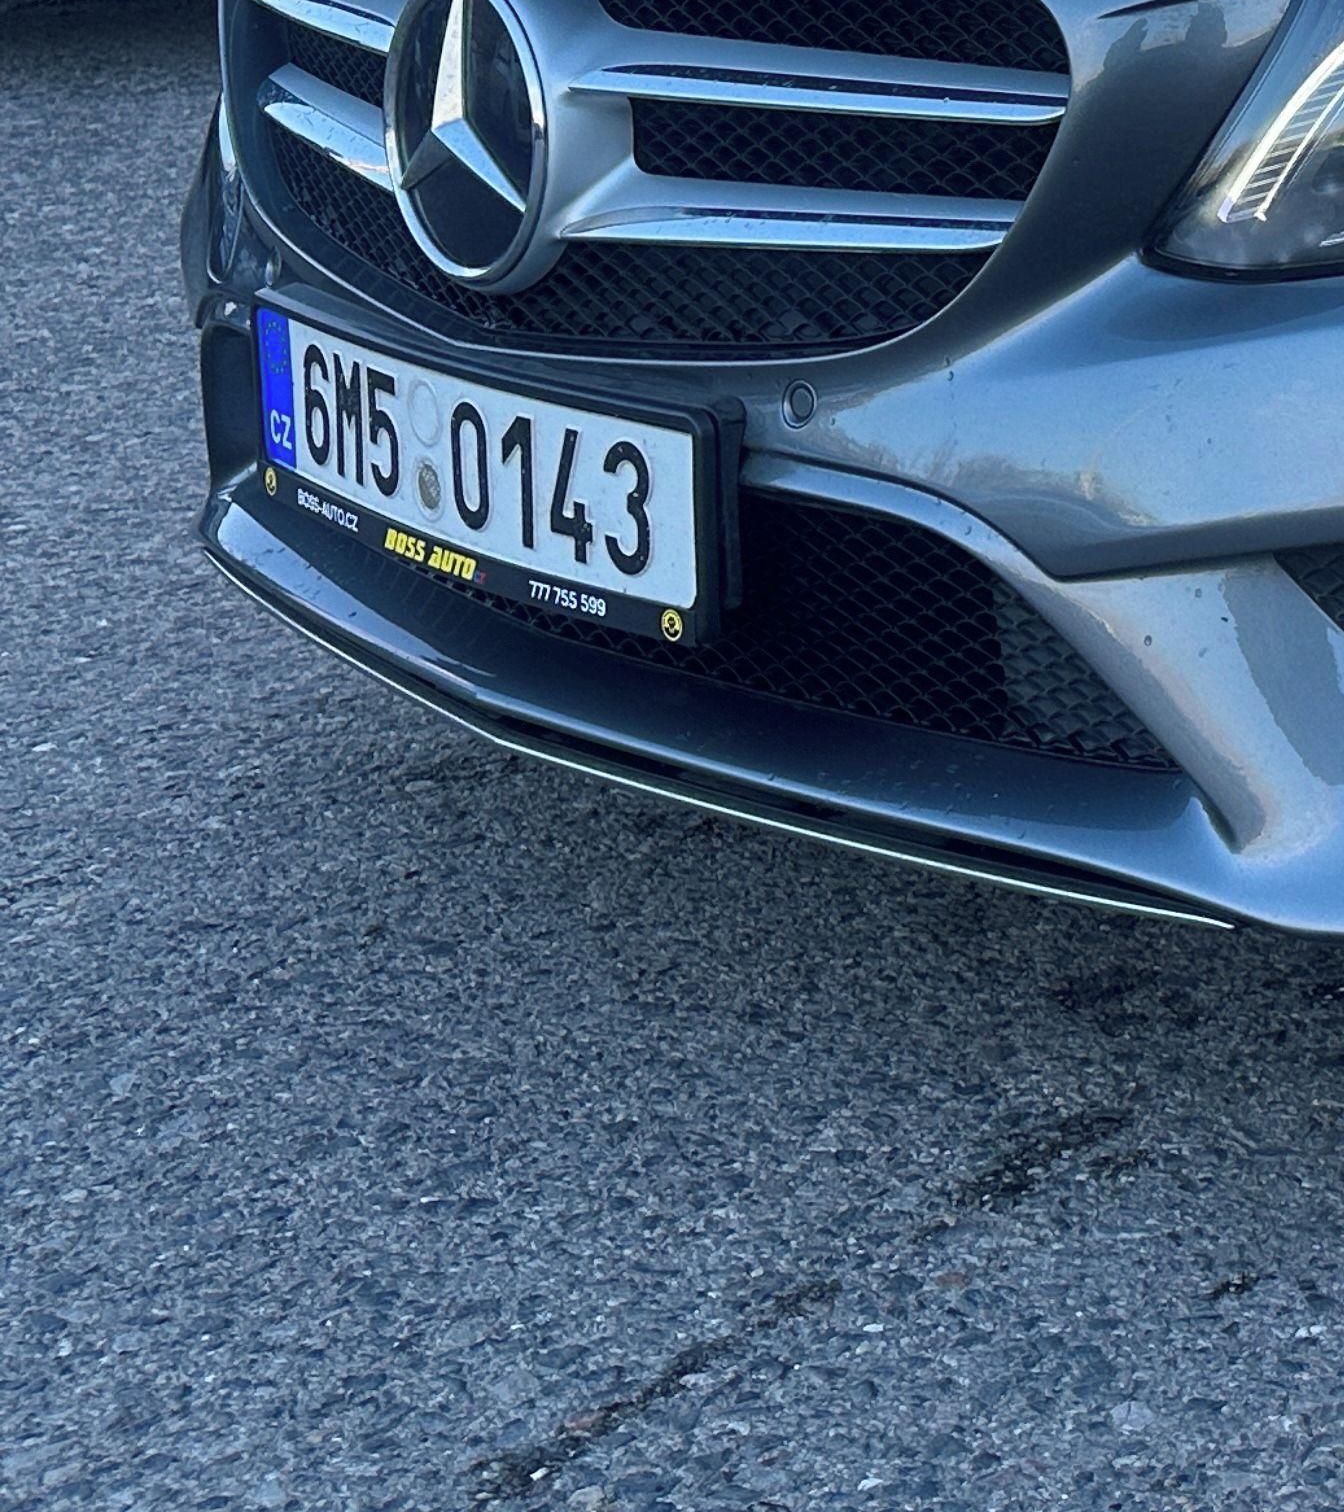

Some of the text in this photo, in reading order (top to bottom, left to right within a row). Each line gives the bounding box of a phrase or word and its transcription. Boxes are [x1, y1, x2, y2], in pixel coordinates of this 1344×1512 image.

[270, 409, 292, 450] CZ
[304, 344, 651, 576] 6M5 0143
[297, 488, 359, 533] BOSS-AUTO.CZ
[384, 528, 426, 563] BOSS
[427, 546, 477, 581] AUTO
[529, 580, 606, 617] 777 755 599
